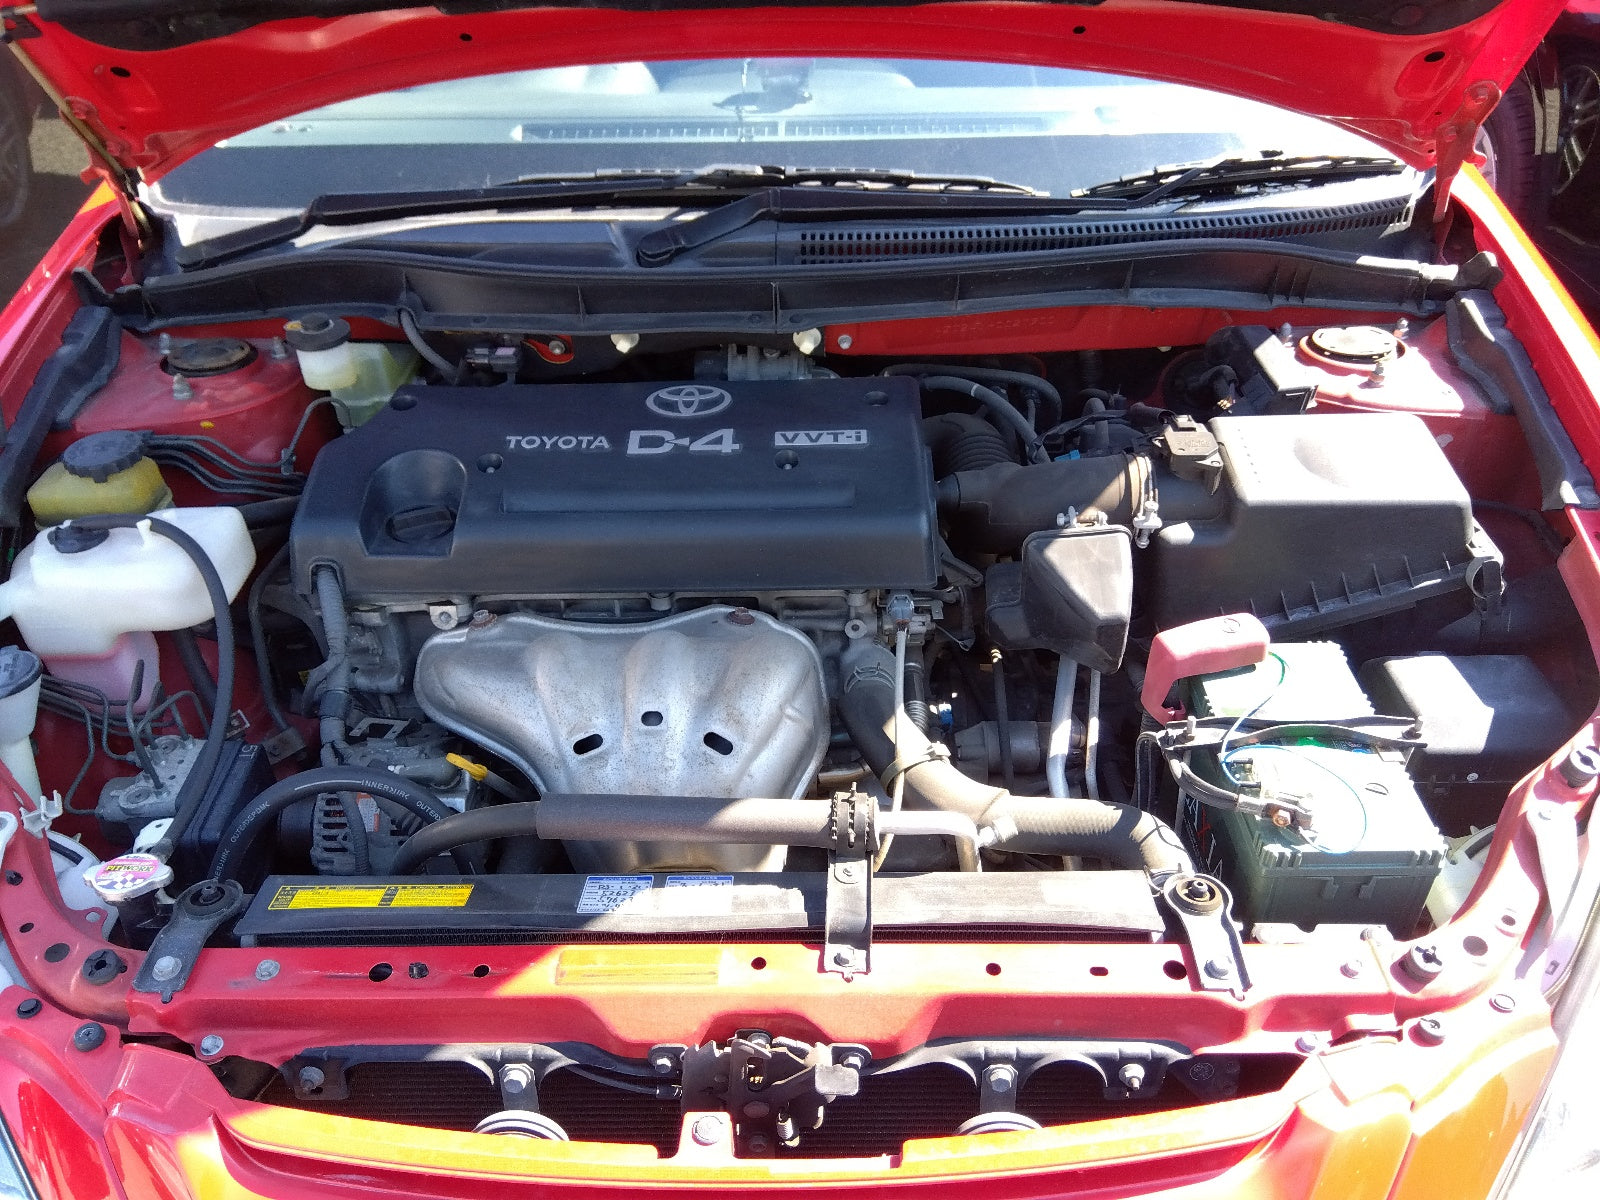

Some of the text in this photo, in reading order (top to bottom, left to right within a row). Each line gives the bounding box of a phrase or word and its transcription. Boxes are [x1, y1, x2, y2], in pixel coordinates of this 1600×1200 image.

[505, 435, 611, 450] TOYOTA
[626, 428, 741, 455] D-4
[776, 431, 867, 446] VVT-i
